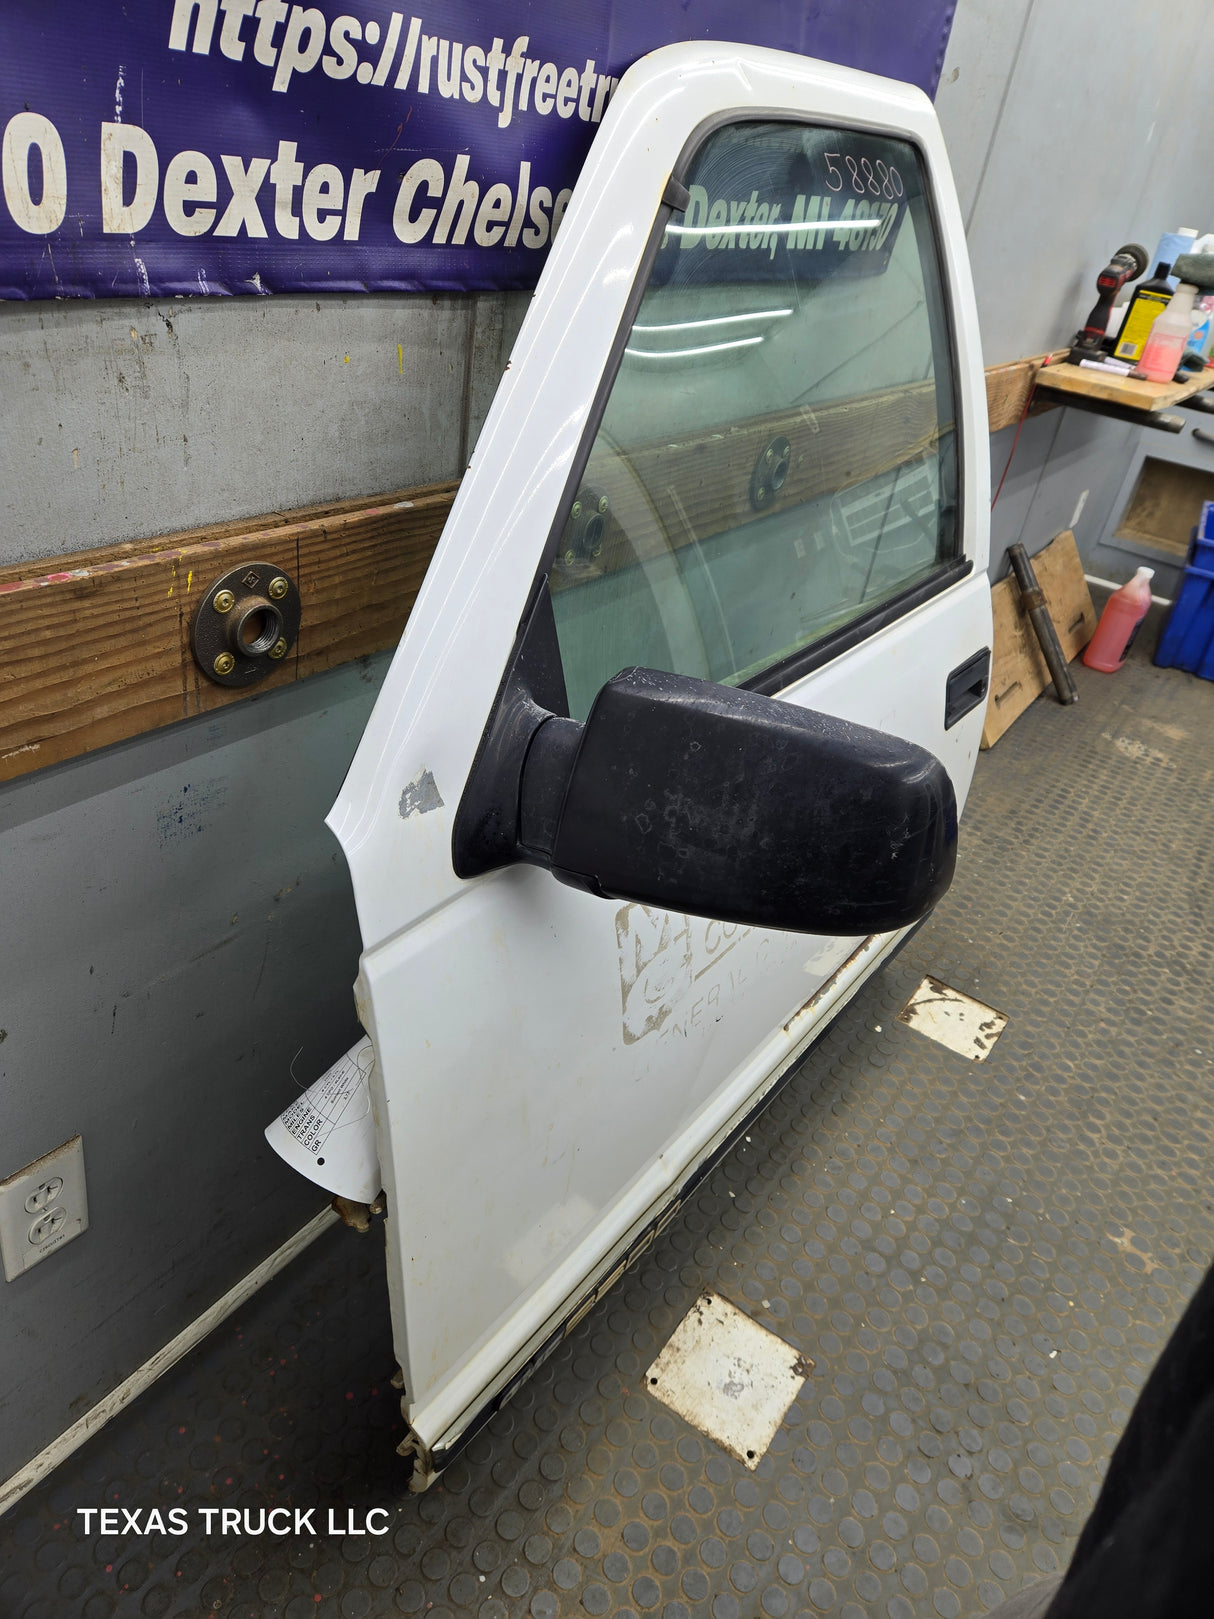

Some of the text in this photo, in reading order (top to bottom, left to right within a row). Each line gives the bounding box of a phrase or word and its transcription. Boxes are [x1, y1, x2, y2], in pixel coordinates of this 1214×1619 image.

[168, 0, 619, 128] https://rustfreetr
[101, 121, 382, 241] Dexter
[824, 152, 904, 200] 58880
[786, 194, 832, 250] MI
[291, 1107, 312, 1135] ENGINE
[297, 1114, 316, 1140] TRANS
[303, 1118, 323, 1146] COLOR
[311, 1139, 322, 1152] GR
